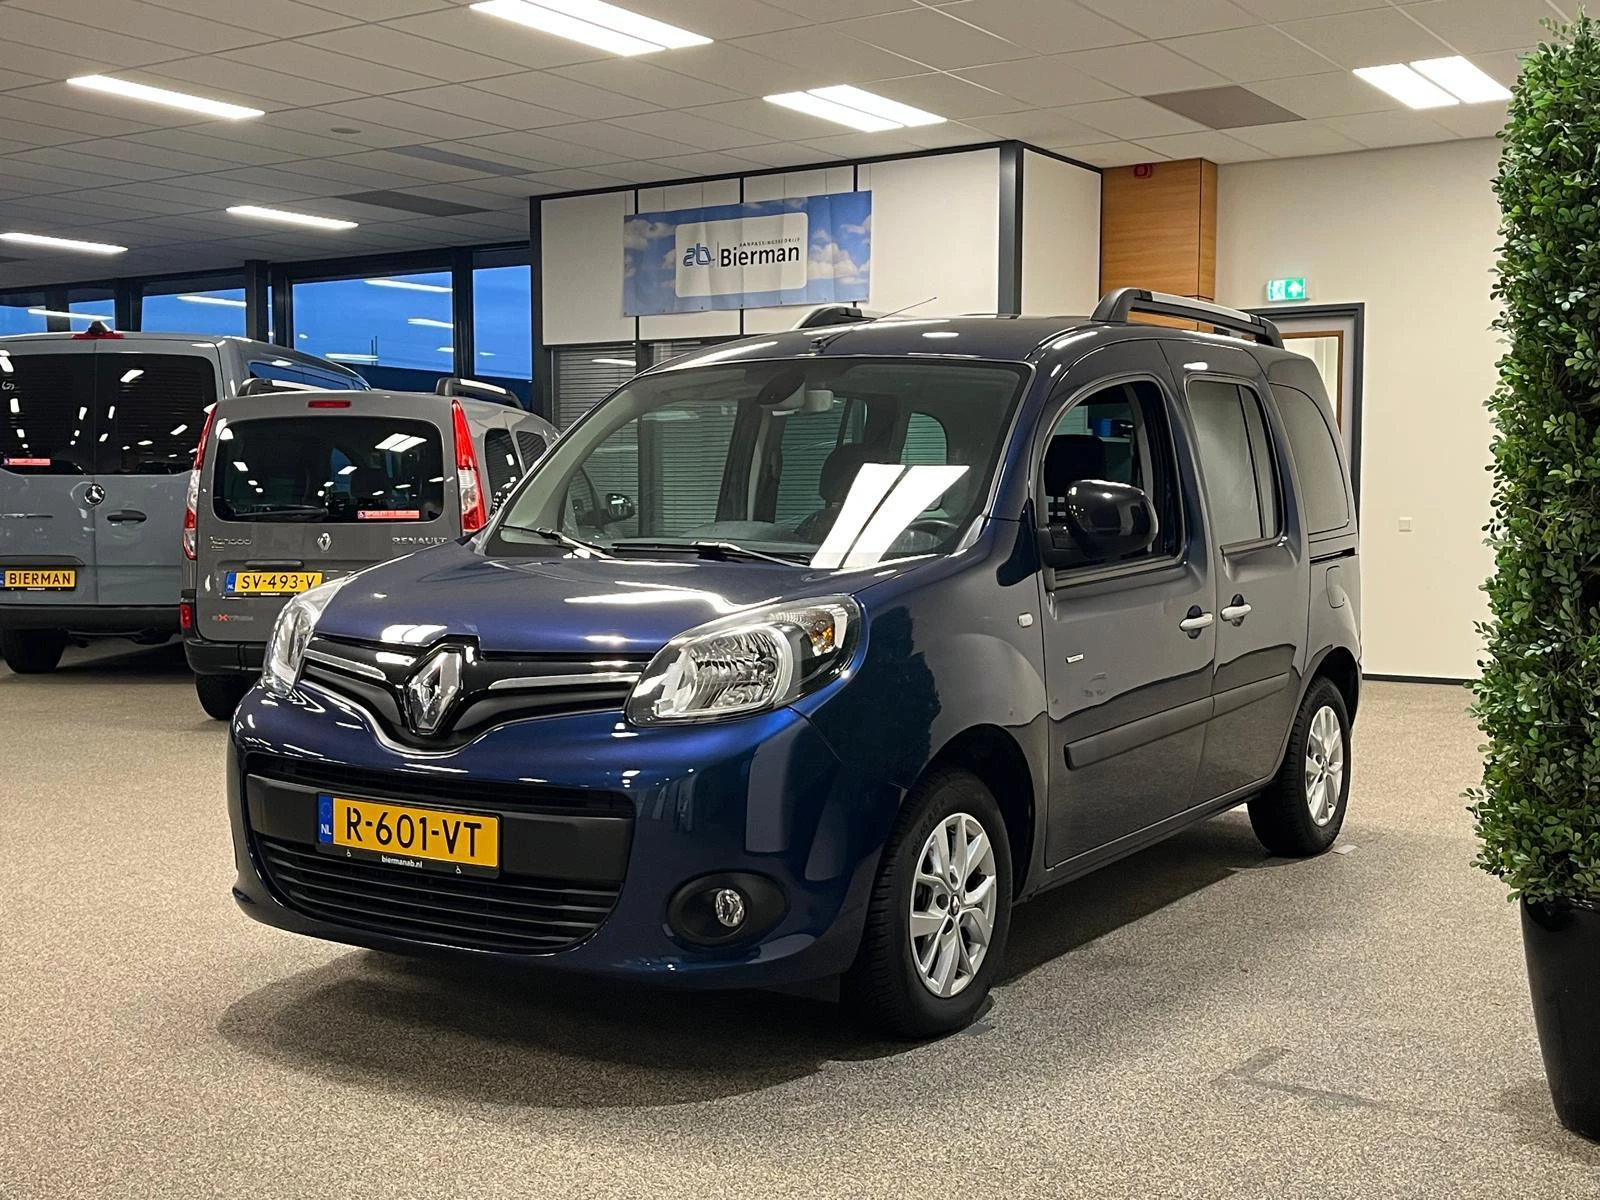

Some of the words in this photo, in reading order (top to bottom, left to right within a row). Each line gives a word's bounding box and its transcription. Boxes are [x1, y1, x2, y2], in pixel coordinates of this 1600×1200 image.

[720, 246, 800, 267] Bierman
[392, 537, 448, 545] RENAULT
[9, 572, 71, 585] BIERMAN
[241, 575, 316, 590] SV-493-V
[320, 824, 332, 835] NL
[346, 806, 482, 857] R-601-VT
[381, 855, 423, 868] biermanab.nl
